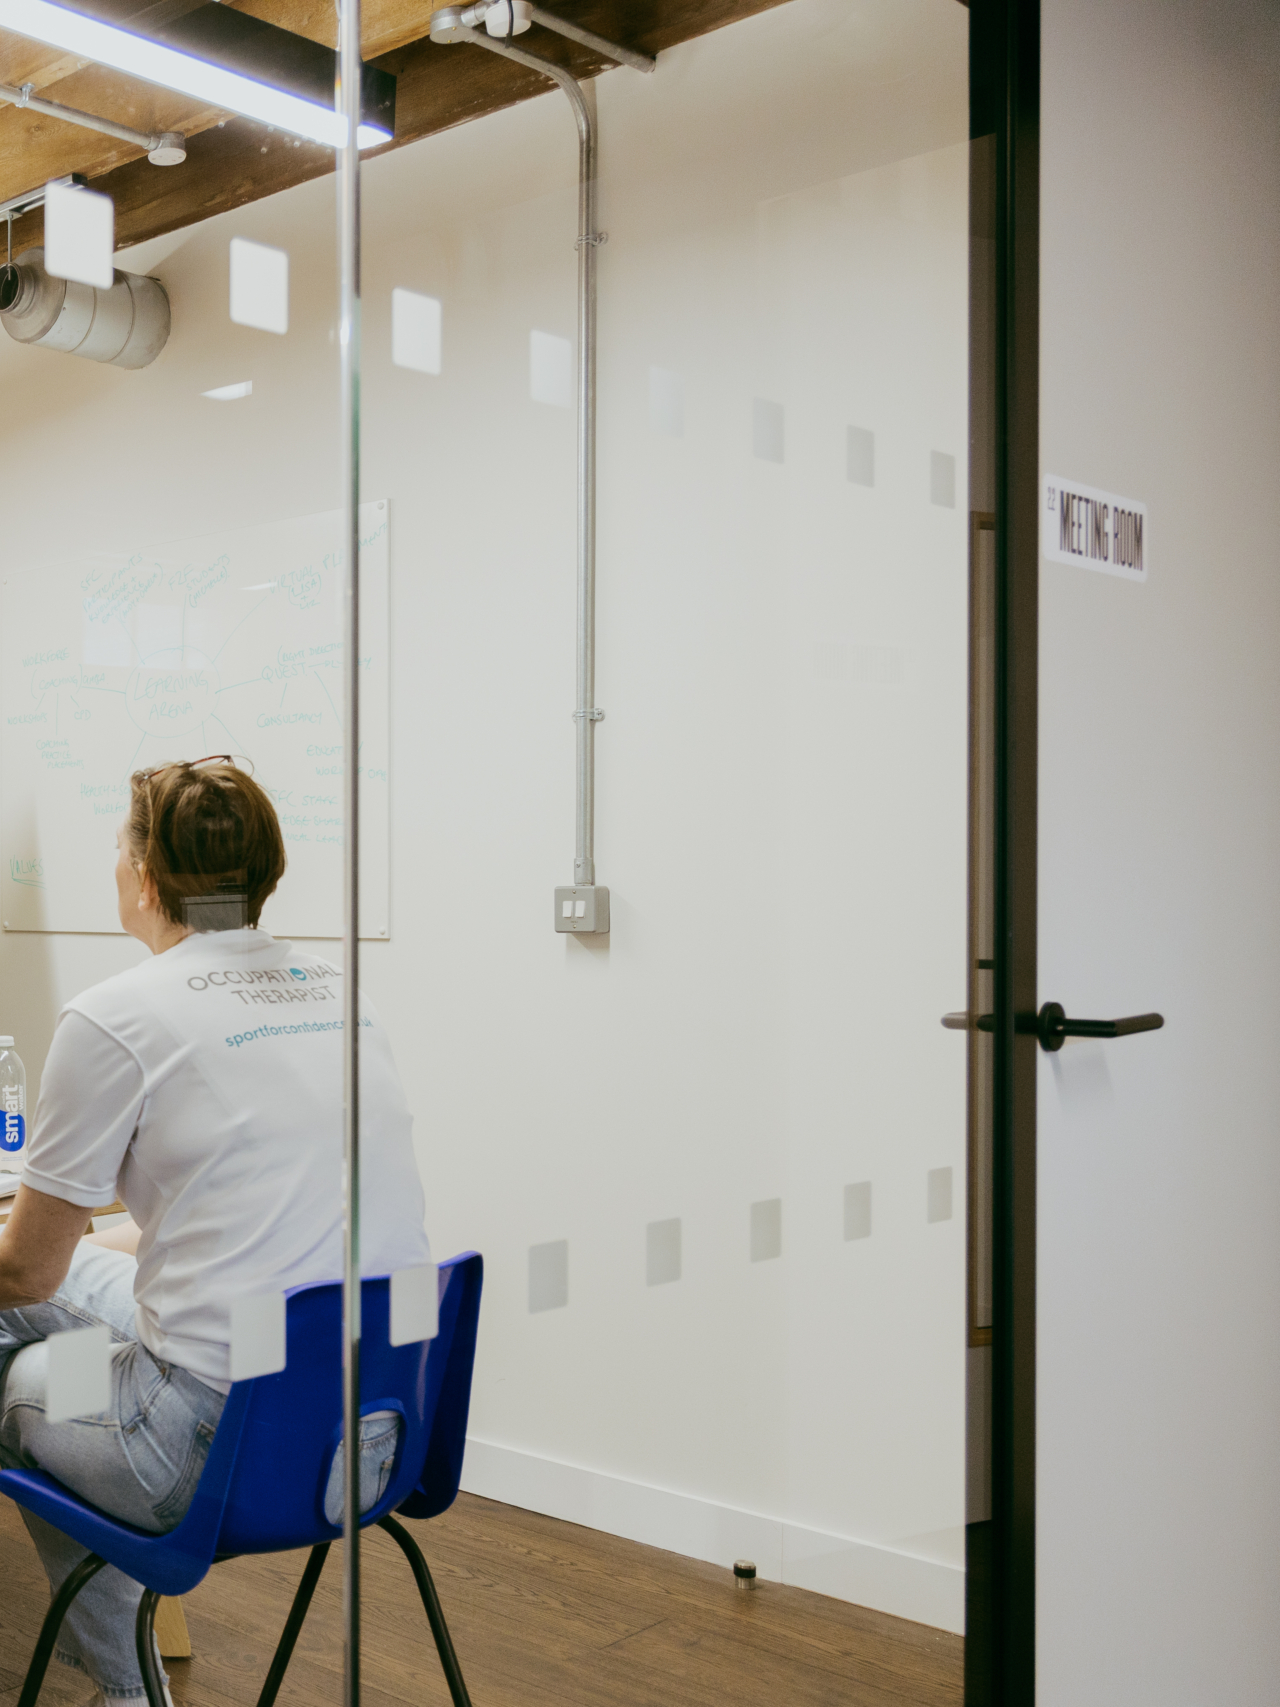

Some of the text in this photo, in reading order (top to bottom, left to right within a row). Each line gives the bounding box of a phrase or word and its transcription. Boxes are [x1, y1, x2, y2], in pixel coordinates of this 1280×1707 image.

[1059, 489, 1143, 571] MEETING ROOM
[22, 647, 71, 668] WORKFORCE
[133, 670, 209, 701] LEARNING
[73, 709, 92, 721] CPD
[148, 701, 194, 721] ARENA
[256, 711, 323, 729] CONSULTANCY
[93, 801, 130, 816] WORKFOR
[9, 854, 44, 877] VALUES
[187, 963, 344, 991] OCCUPATIONAL
[230, 985, 337, 1005] THERAPIST
[2, 1084, 19, 1144] smart
